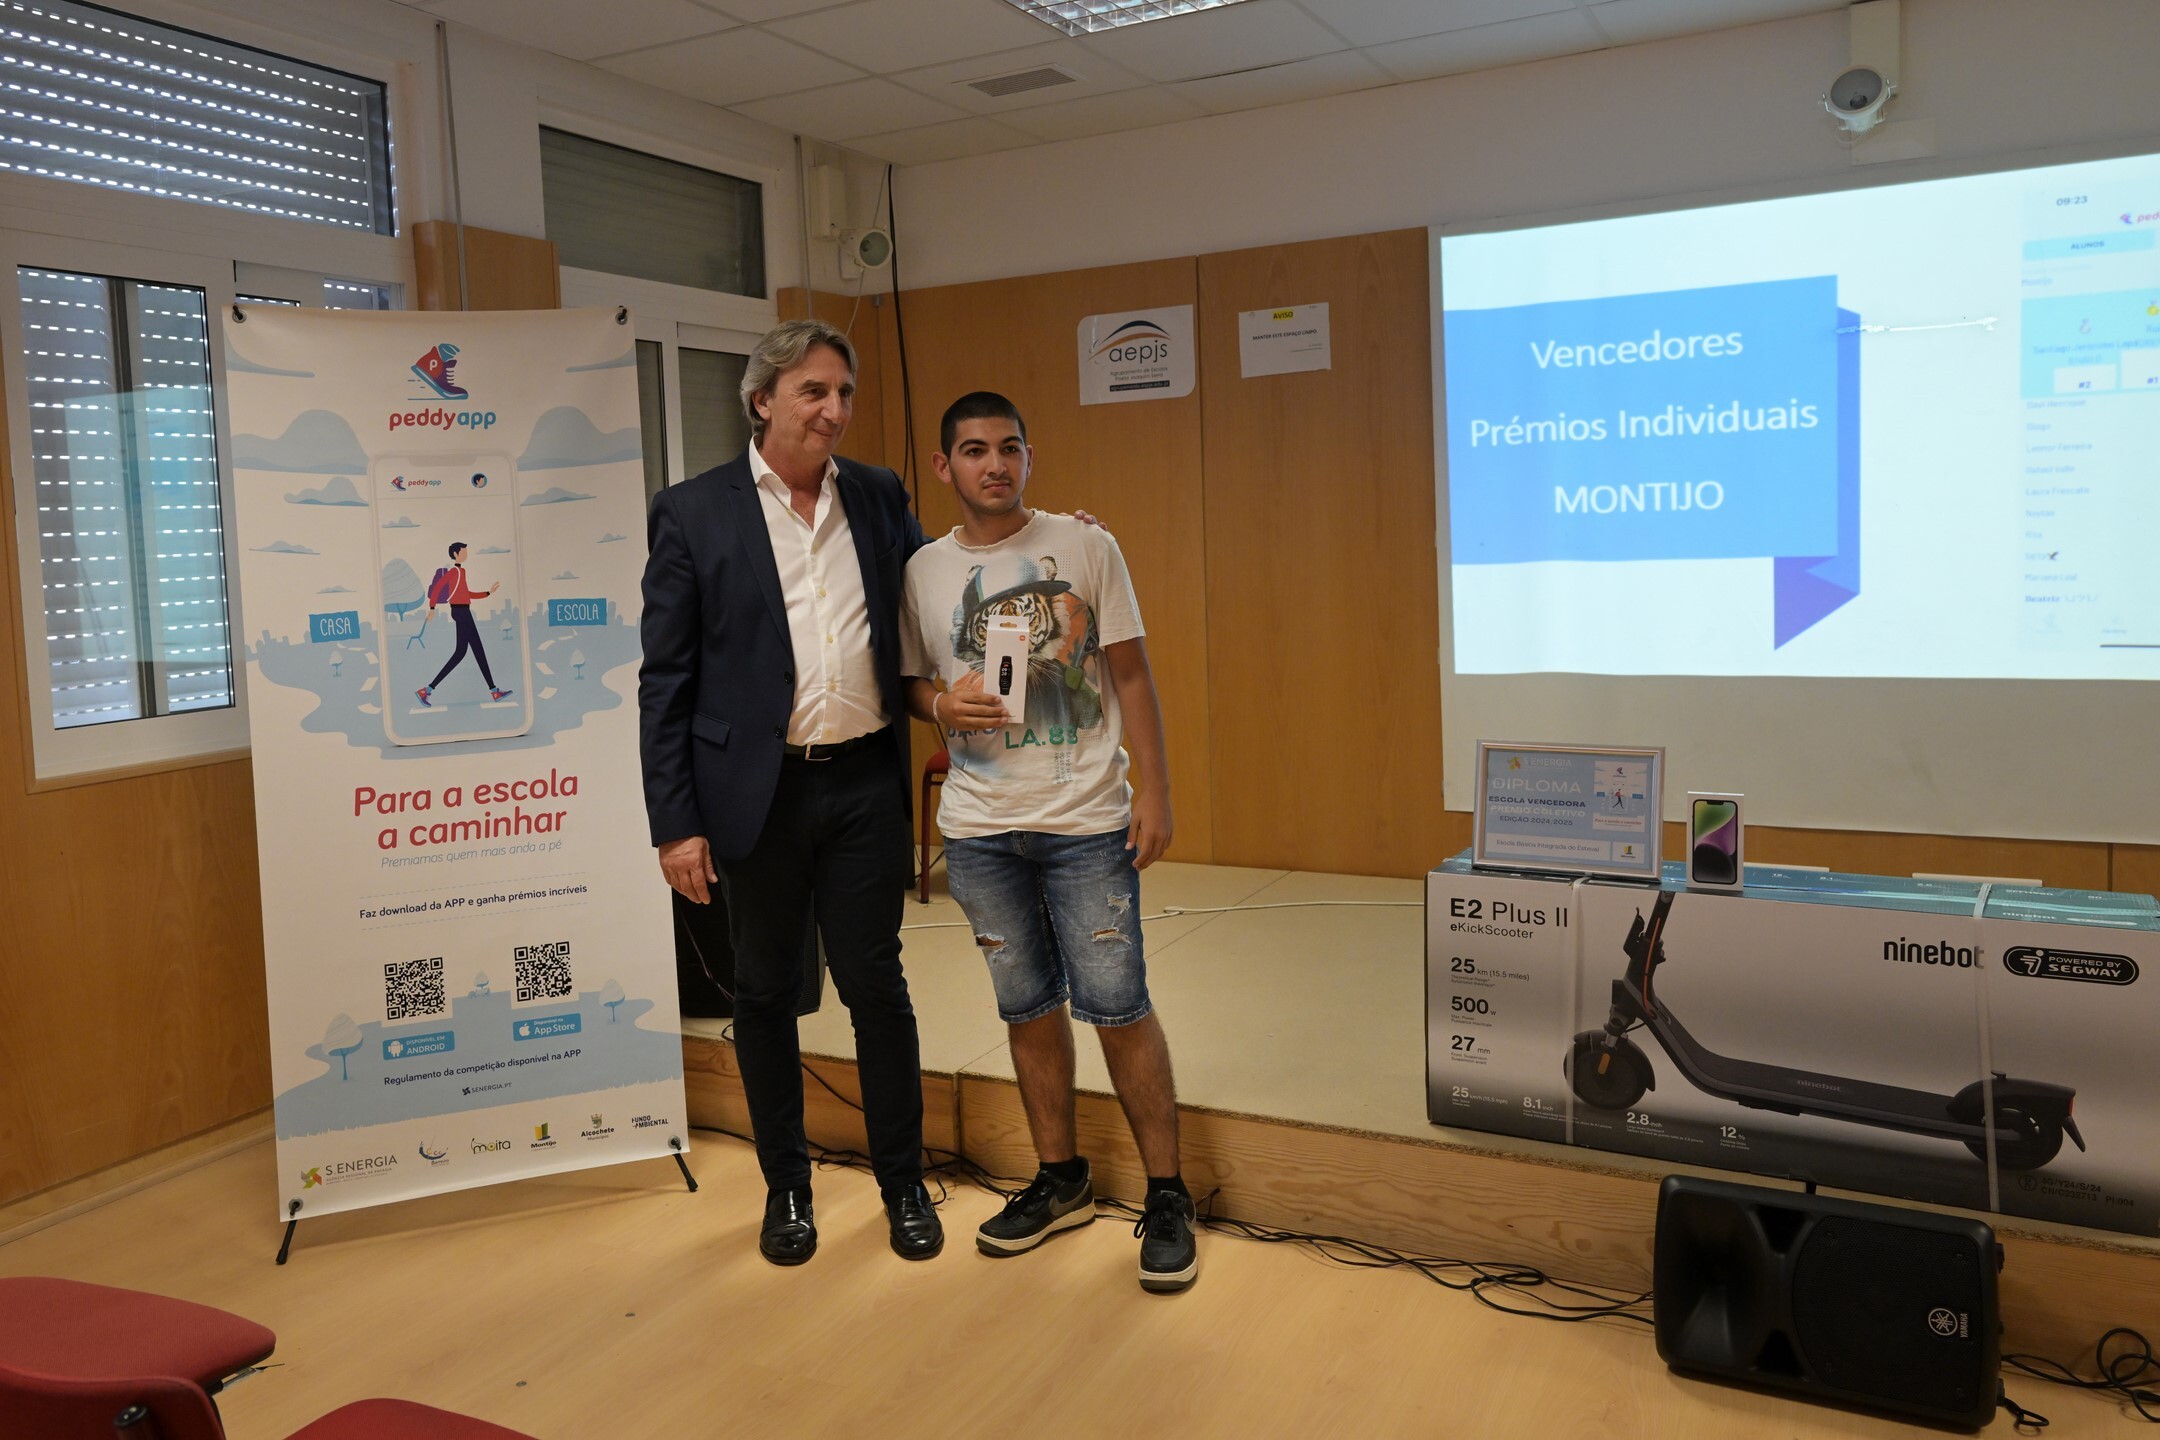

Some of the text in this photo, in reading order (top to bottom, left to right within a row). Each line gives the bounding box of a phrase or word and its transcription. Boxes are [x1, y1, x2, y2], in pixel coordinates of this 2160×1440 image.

[2056, 195, 2088, 207] 09:23
[2070, 240, 2105, 250] ALUNOS
[1273, 311, 1294, 319] AVISO
[1109, 339, 1168, 364] aepjs
[1530, 327, 1744, 369] Vencedores
[389, 407, 497, 431] peddyapp
[1470, 398, 1820, 449] Prémios Individuais
[408, 478, 442, 487] peddyapp
[1553, 480, 1724, 515] MONTIJO
[556, 602, 600, 622] ESCOLA
[319, 616, 353, 637] CASA
[354, 768, 578, 817] Para a escola
[1492, 777, 1582, 794] DIPLOMA
[1488, 795, 1586, 808] ESCOLA VENCEDORA
[1533, 807, 1586, 818] COLETIVO
[378, 806, 567, 850] a caminhar
[381, 839, 562, 869] Premiamos quem mais anda a pé
[1537, 842, 1567, 851] Integrada
[359, 909, 377, 919] Faz
[379, 902, 427, 917] download
[429, 900, 442, 911] da
[444, 897, 465, 909] APP
[476, 894, 506, 907] ganha
[508, 888, 547, 903] prémios
[549, 884, 588, 897] incríveis
[1450, 897, 1568, 928] E2 Plus II
[1450, 922, 1534, 939] eKickScooter
[1883, 936, 1985, 970] ninebot
[2048, 956, 2121, 968] POWERED BY
[1451, 957, 1530, 982] 25 km (15.5 miles)
[2048, 964, 2122, 978] SEGWAY
[1451, 995, 1489, 1015] 500
[534, 1022, 576, 1036] App Store
[406, 1042, 446, 1056] ANDROID
[1451, 1034, 1491, 1055] 27 mm
[384, 1048, 582, 1086] Regulamento da competição disponível na APP
[1452, 1085, 1469, 1099] 25
[580, 1127, 615, 1138] Alcochete
[1720, 1125, 1737, 1139] 12
[471, 1138, 511, 1155] moita
[530, 1140, 557, 1149] Montijo
[325, 1154, 398, 1176] S.ENERGIA
